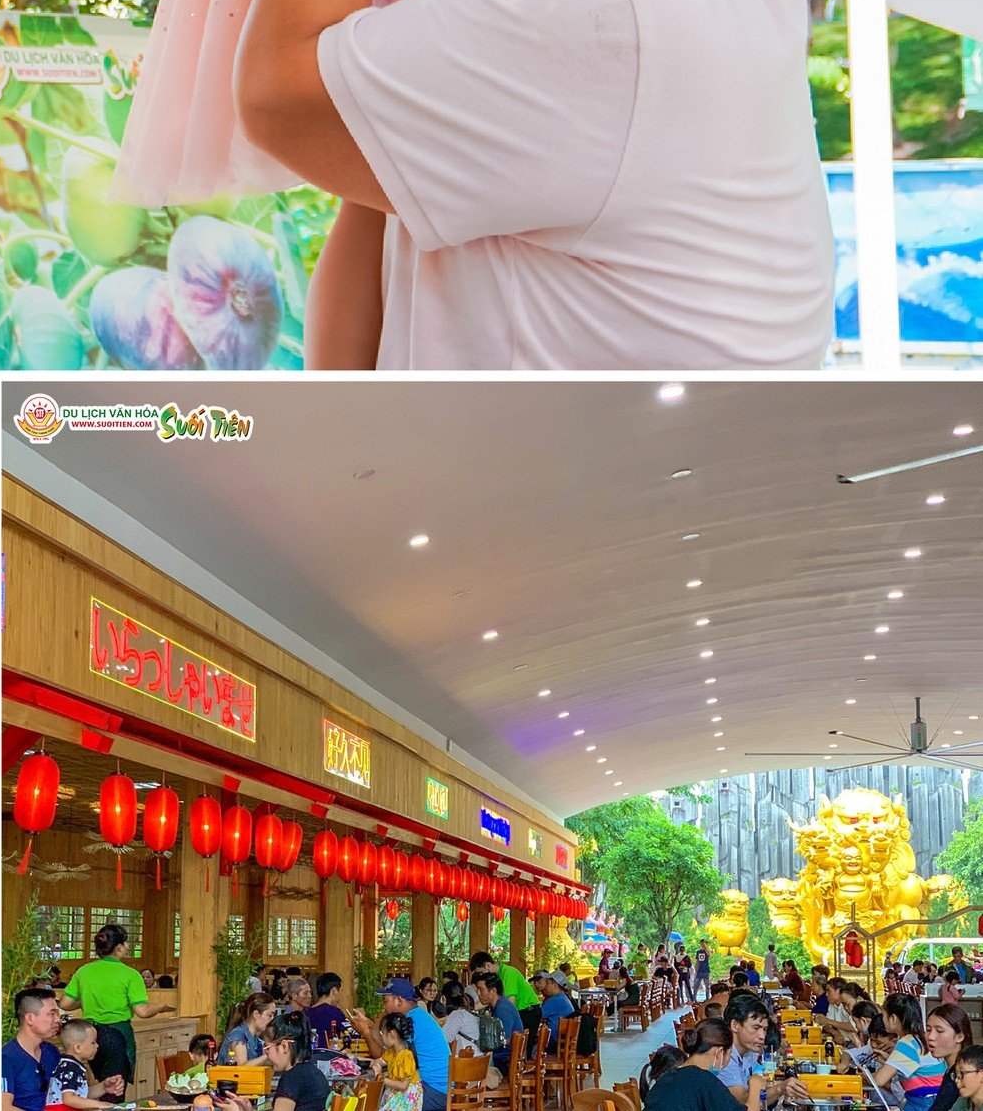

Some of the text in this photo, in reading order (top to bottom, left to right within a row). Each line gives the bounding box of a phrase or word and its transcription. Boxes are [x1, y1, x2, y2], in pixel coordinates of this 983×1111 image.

[3, 50, 19, 63] DU
[93, 608, 254, 737] いらっしゃいませ
